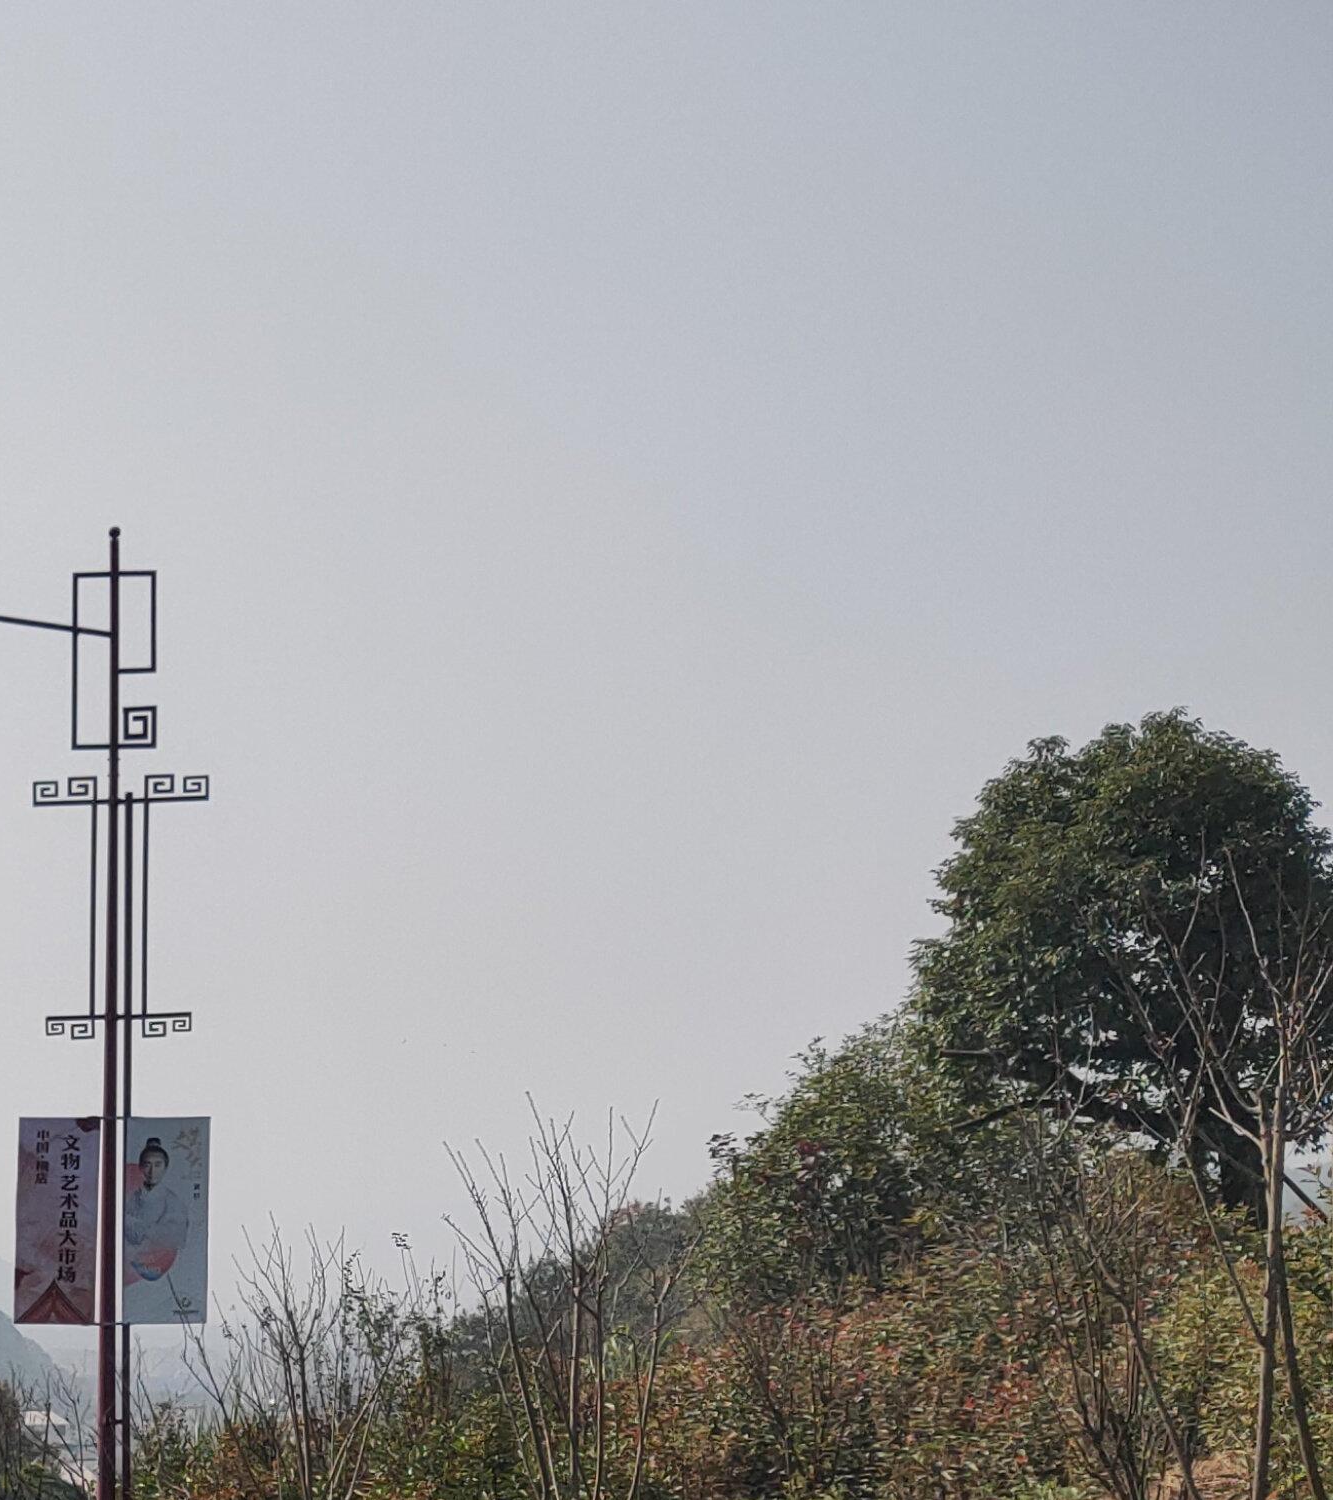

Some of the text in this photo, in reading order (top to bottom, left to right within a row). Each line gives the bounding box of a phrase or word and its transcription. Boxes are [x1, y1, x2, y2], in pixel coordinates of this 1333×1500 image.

[56, 1134, 81, 1284] 文物艺术品大市场
